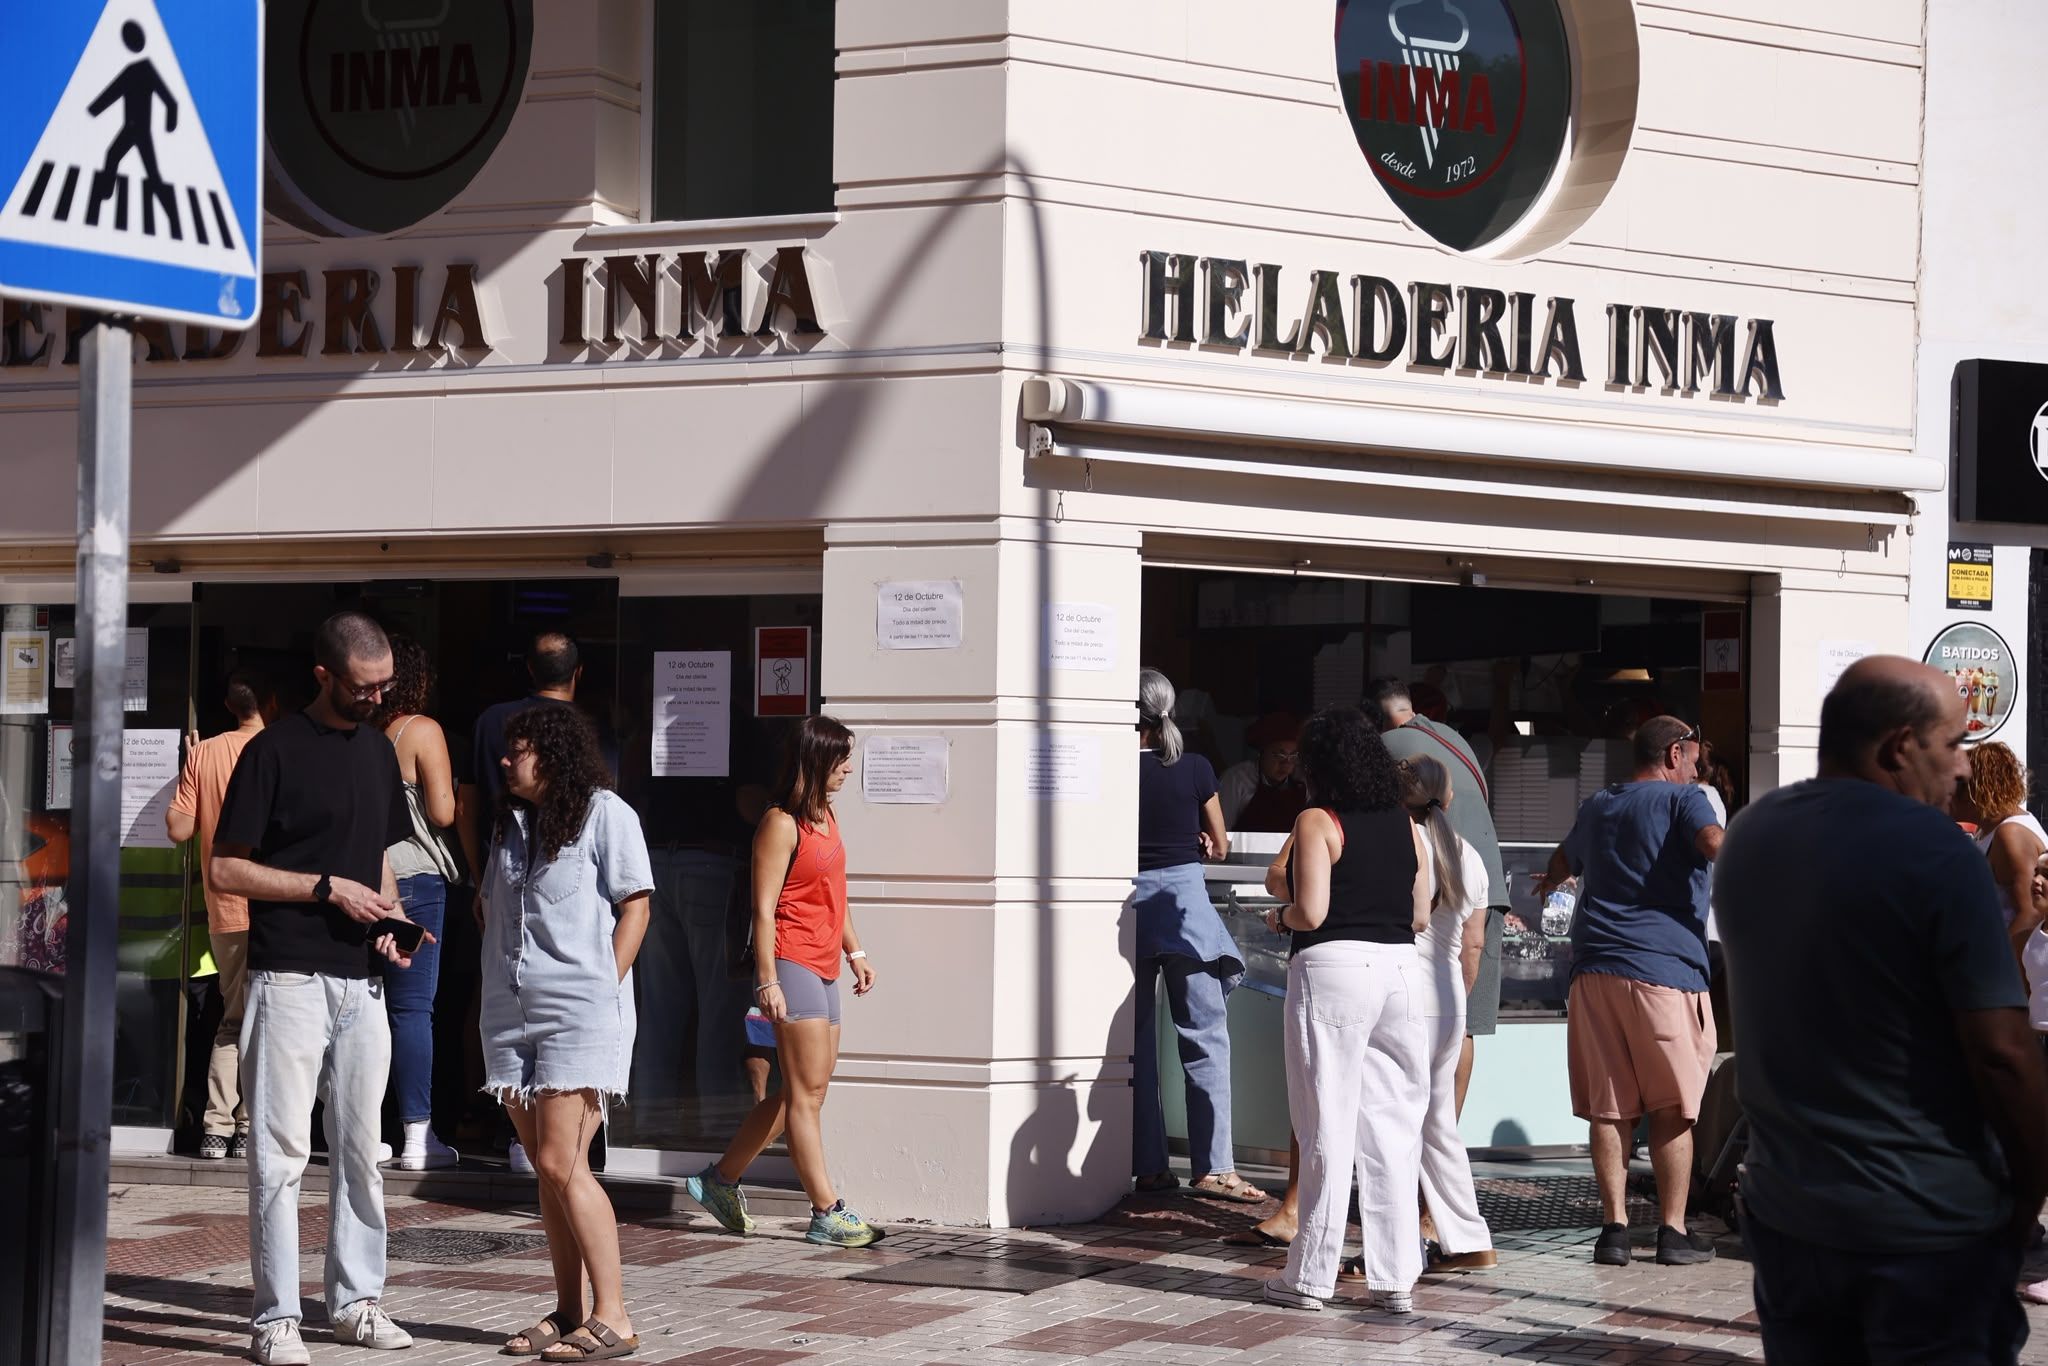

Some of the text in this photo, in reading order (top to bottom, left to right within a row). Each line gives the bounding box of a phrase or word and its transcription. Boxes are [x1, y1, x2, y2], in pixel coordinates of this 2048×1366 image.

[330, 43, 482, 112] INMA
[1358, 57, 1497, 137] INMA
[1380, 151, 1476, 184] desde 1972
[560, 246, 828, 346] INMA
[1138, 249, 1786, 404] HELADERIA INMA
[894, 592, 944, 601] 12 de Octubre
[1056, 613, 1101, 623] 12 de Octubre
[1942, 646, 1999, 660] BATIDOS
